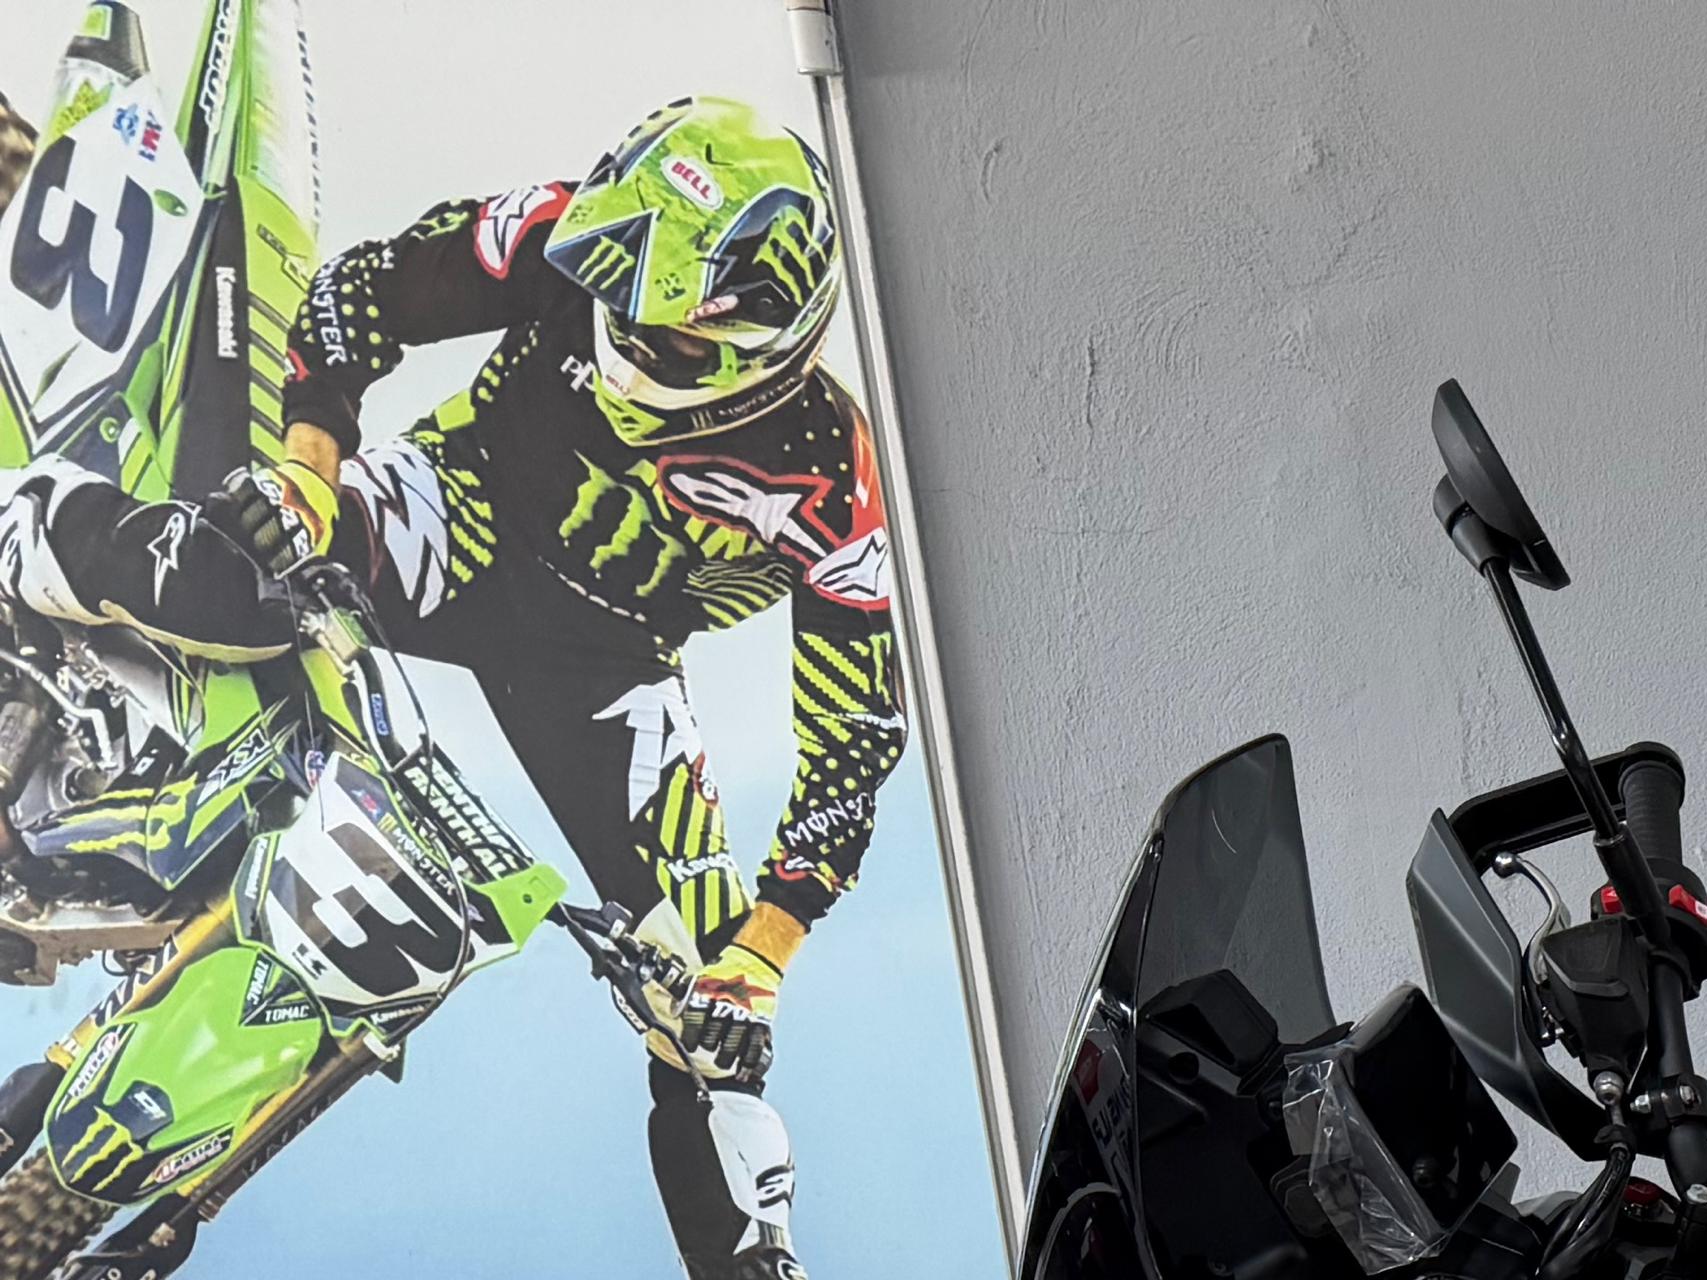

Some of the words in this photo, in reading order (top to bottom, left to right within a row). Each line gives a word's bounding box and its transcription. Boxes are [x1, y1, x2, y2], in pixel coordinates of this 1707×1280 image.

[671, 161, 713, 200] BELL
[215, 266, 239, 358] Kawasaki
[312, 256, 348, 367] ONSTER
[404, 766, 508, 880] RENTHAL
[268, 821, 475, 997] 3
[264, 1004, 310, 1024] TOMAC
